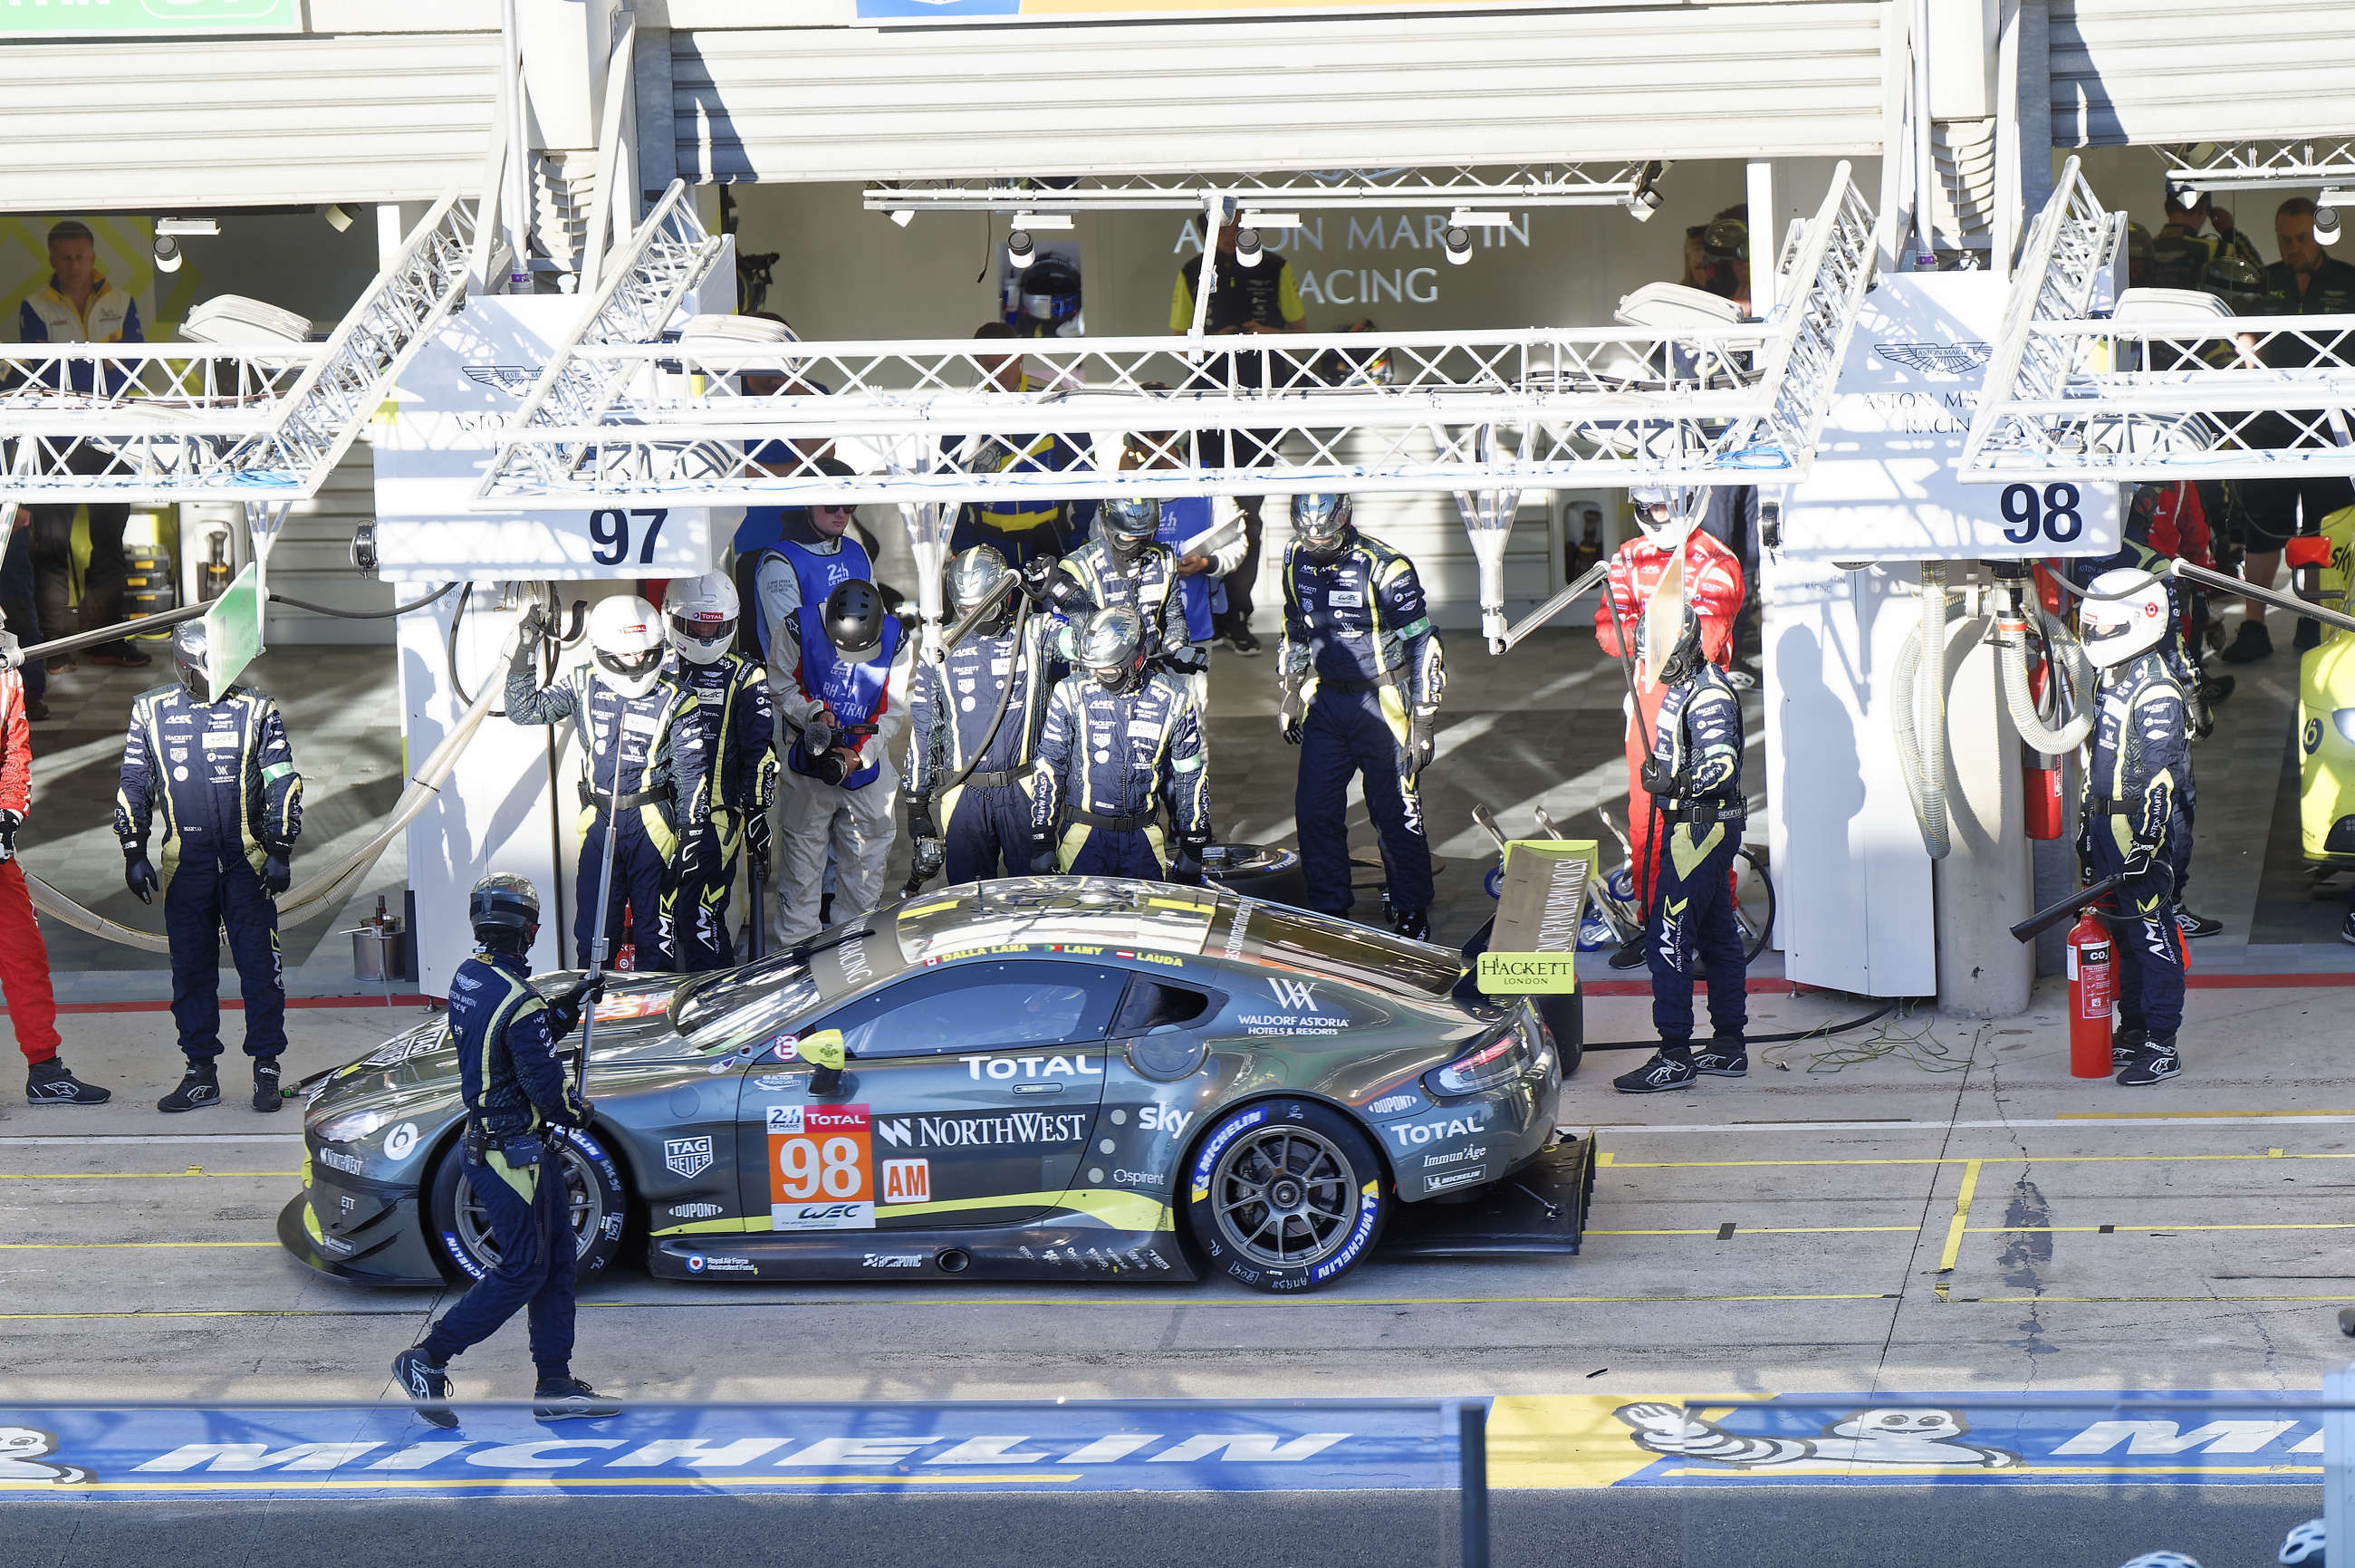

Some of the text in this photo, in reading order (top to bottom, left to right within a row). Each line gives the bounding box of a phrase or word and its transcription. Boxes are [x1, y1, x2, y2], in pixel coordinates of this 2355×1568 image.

[1174, 212, 1530, 253] AON MARIN
[1298, 268, 1438, 304] ACING
[1862, 391, 1933, 409] ASTON
[1905, 417, 1971, 434] RACIN
[2001, 483, 2082, 544] 98
[590, 507, 668, 565] 97
[823, 681, 839, 697] RH
[2153, 787, 2163, 815] MARTIN
[1718, 807, 1742, 820] sparco
[658, 887, 678, 959] AMR
[696, 883, 726, 952] AMR
[2136, 893, 2172, 961] AMR
[1659, 894, 1688, 968] AMR
[942, 943, 1030, 963] DALLA LANA
[1063, 944, 1104, 956] LAMY
[1136, 952, 1184, 967] LAUDA
[1481, 958, 1571, 976] HACKETT
[1504, 977, 1549, 986] LONDON
[1238, 1015, 1349, 1028] WALDORF ASTORIA
[1248, 1027, 1339, 1036] HOTELS & RESORTS
[959, 1054, 1102, 1081] TOTAL
[1374, 1095, 1411, 1114] DUPONT
[806, 1113, 866, 1125] TOTAL
[1139, 1101, 1194, 1140] sky
[1390, 1116, 1485, 1146] TOTAL
[668, 1140, 708, 1153] TAG
[1198, 1111, 1262, 1173] MICHELIN
[668, 1154, 710, 1175] HEUER
[779, 1137, 861, 1199] 98
[887, 1164, 928, 1198] AM
[1439, 1169, 1481, 1186] MICHELIN
[675, 1203, 717, 1217] DUPONT
[798, 1204, 861, 1219] WEC
[1318, 1212, 1373, 1279] MICHELIN
[706, 1257, 724, 1265] Royal
[130, 1433, 1353, 1472] MICHELIN
